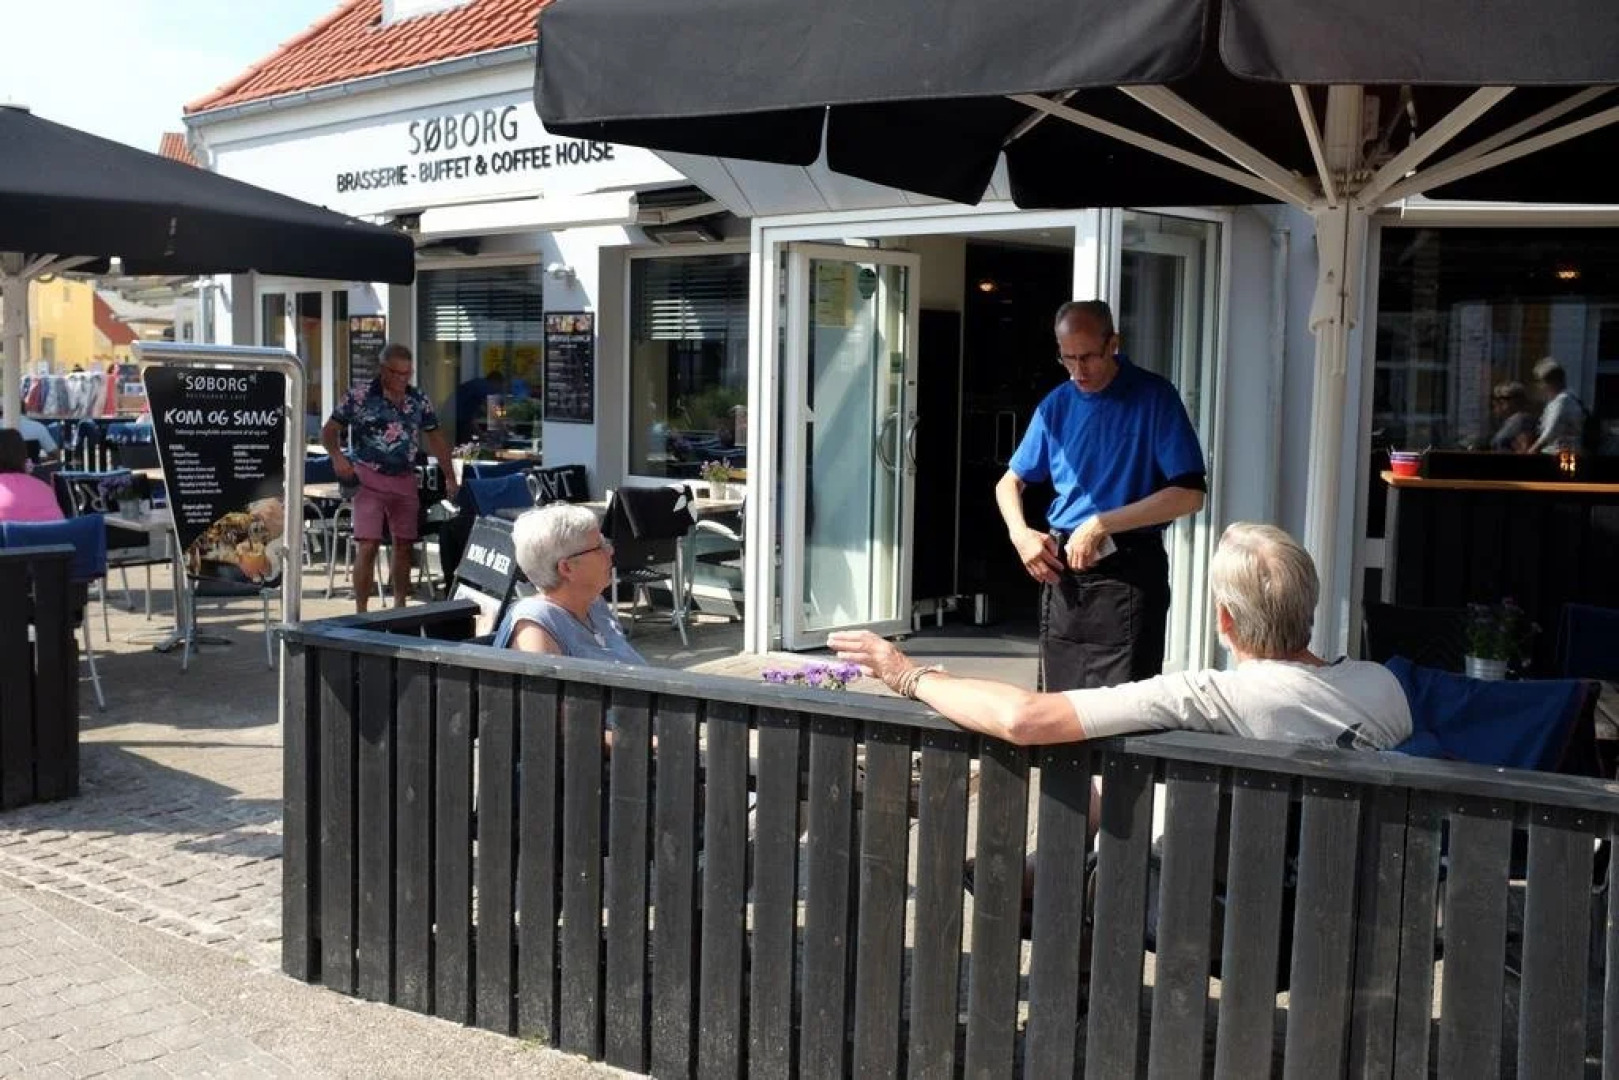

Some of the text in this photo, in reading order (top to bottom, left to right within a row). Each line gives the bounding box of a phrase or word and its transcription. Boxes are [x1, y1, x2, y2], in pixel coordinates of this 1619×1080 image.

[408, 106, 518, 154] SØBORG
[337, 166, 408, 193] BRASSERIE
[419, 156, 472, 183] BUFFET
[475, 152, 488, 176] &
[491, 145, 551, 174] COFFEE
[556, 141, 615, 165] HOUSE
[185, 375, 248, 392] SØBORG
[164, 408, 203, 425] KOM
[208, 409, 229, 426] OG
